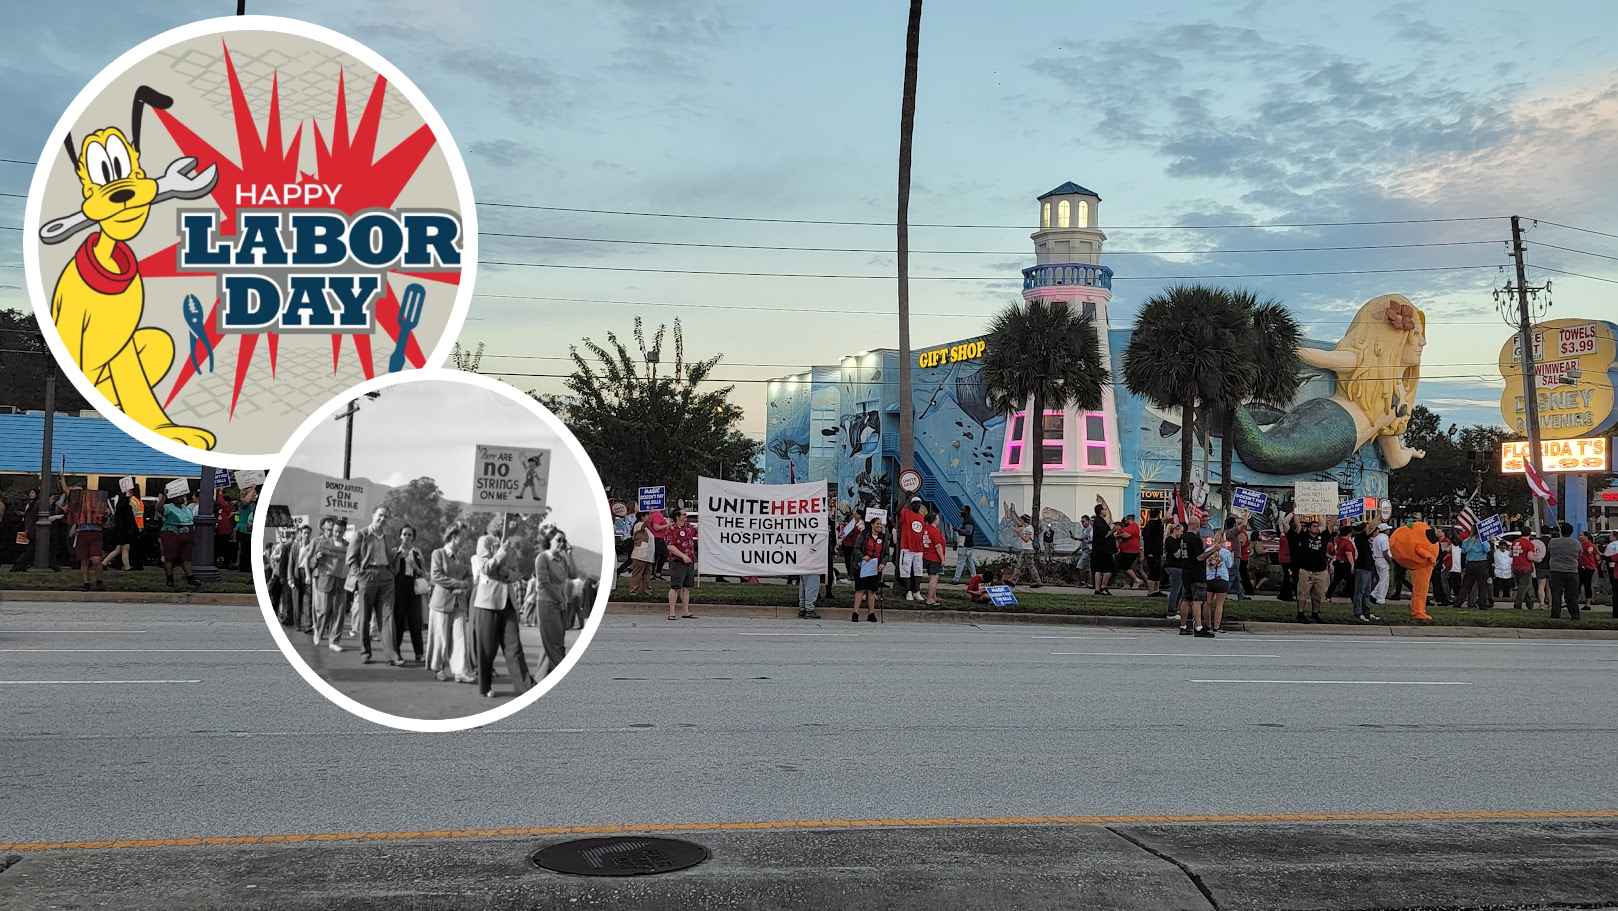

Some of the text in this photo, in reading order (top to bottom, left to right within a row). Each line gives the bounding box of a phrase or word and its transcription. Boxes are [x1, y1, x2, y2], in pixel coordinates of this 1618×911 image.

[1560, 326, 1595, 341] TOWELS
[919, 339, 986, 368] GIFT SHOP
[1561, 340, 1594, 354] $3.99
[1534, 361, 1577, 375] WIMWEAR
[497, 453, 513, 462] ARE
[337, 491, 352, 500] ON
[480, 490, 494, 500] ON
[716, 516, 819, 530] THE FIGHTING
[720, 532, 817, 545] HOSPITALITY
[741, 550, 797, 565] UNION
